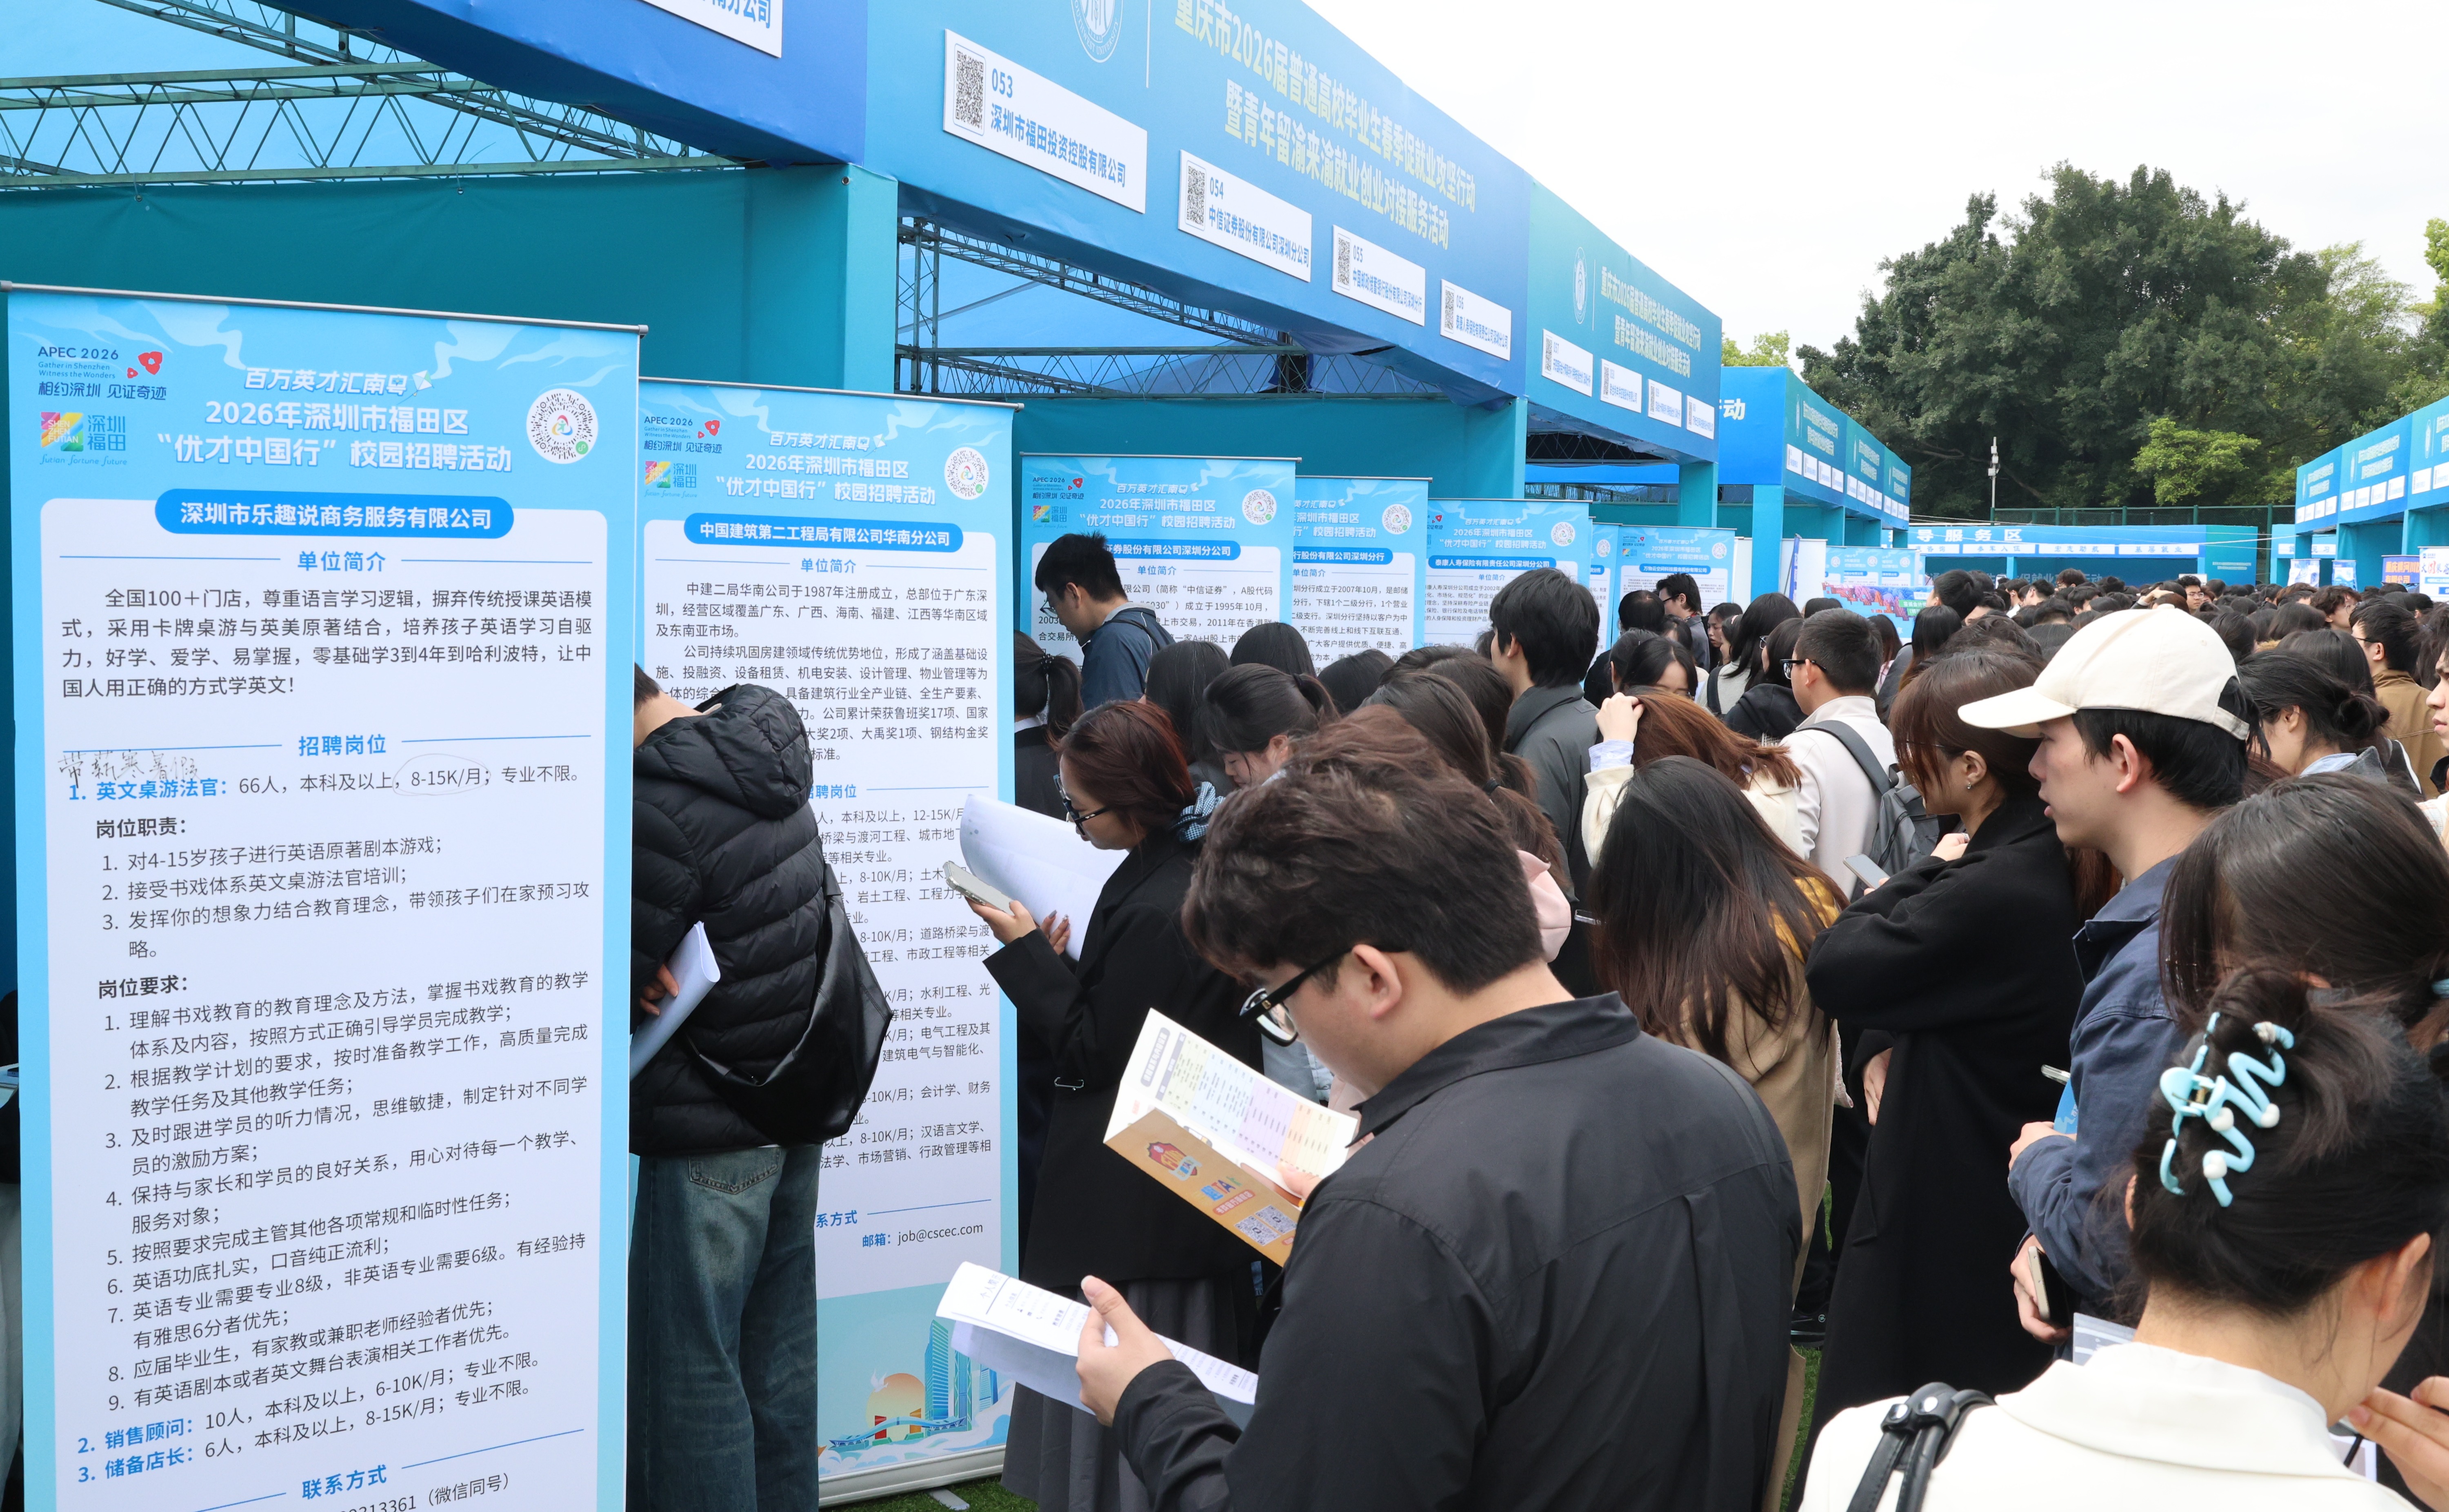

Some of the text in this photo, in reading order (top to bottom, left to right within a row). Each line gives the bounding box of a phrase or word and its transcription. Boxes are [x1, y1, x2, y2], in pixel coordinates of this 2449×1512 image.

[1096, 18, 1118, 55] UNIVERSITY
[991, 67, 1014, 99] 053
[1175, 0, 1475, 213] 重庆市2026届普通高校毕业生春季促就业攻坚行动
[991, 102, 1127, 188] 深圳市福田投资控股有限公司
[1225, 78, 1449, 250] 暨青年留渝来渝就业创业对接服务活动
[1209, 176, 1224, 201] 054
[1209, 205, 1309, 268] 中信证券股份有限公司深圳分公司
[1353, 244, 1363, 263] 055
[1353, 267, 1422, 313] 中国邮政储蓄银行股份有限公司深圳分行
[1456, 294, 1464, 310] 056
[38, 346, 119, 360] APEC 2026
[38, 382, 167, 401] 相约深圳 见证奇迹
[244, 366, 407, 396] 百万英才汇南粤
[48, 420, 70, 428] SHEN
[88, 415, 126, 433] 深圳
[205, 400, 469, 435] 2026年深圳市福田区
[644, 416, 693, 426] APEC 2026
[48, 427, 70, 435] ZHEN
[87, 433, 126, 451] 福田
[644, 440, 722, 454] 相约深圳 见证奇迹
[673, 463, 696, 475] 深圳
[745, 454, 909, 480] 2026年深圳市福田区
[673, 476, 696, 488] 福田
[180, 501, 491, 530] 深圳市乐趣说商务服务有限公司
[1099, 498, 1216, 512] 2026年深圳市福田区
[1293, 512, 1360, 524] 深圳市福田区
[700, 522, 950, 547] 中国建筑第二工程局有限公司华南分公司
[1453, 528, 1533, 538] 2026年深圳市福田区
[1888, 528, 2022, 542] 导服务区
[297, 550, 386, 573] 单位简介
[800, 558, 857, 573] 单位简介
[1293, 550, 1385, 562] 行股份有限公司深圳分行
[1435, 559, 1550, 568] 泰康人寿保险有限责任公司深圳分公司
[1137, 565, 1177, 576] 单位简介
[1293, 568, 1326, 577] 单位简介
[687, 582, 987, 602] 中建二局华南公司于1987年注册成立，总部位于广东深
[656, 603, 988, 622] 圳，经营区域覆盖广东、广西、海南、福建、江西等华南区域
[62, 618, 592, 638] 式，采用卡牌桌游与英美原著结合，培养孩子英语学习自驱
[656, 624, 740, 638] 及东南亚市场。
[1300, 626, 1404, 635] 不断完善线上和线下互联互通、
[62, 644, 591, 668] 力，好学、爱学、易掌握，零基础学3到4年到哈利波特，让中
[684, 645, 988, 661] 公司持续巩固房建领域传统优势地位，形成了涵盖基础设
[656, 666, 988, 680] 施、投融资、设备租赁、机电安装、设计管理、物业管理等为
[63, 676, 294, 698] 国人用正确的方式学英文！
[298, 733, 386, 757] 招聘岗位
[69, 784, 87, 800] 1.
[96, 816, 186, 839] 岗位职责：
[102, 836, 442, 872] 1. 对4-15岁孩子进行英语原著剧本游戏；
[102, 866, 406, 901] 2. 接受书戏体系英文桌游法官培训；
[102, 881, 589, 931] 3. 发挥你的想象力结合教育理念，带领孩子们在家预习攻
[129, 940, 157, 959] 略。
[98, 974, 187, 999] 岗位要求：
[104, 971, 589, 1031] 1. 理解书戏教育的教育理念及方法，掌握书戏教育的教学
[130, 1004, 511, 1059] 体系及内容，按照方式正确引导学员完成教学；
[104, 1023, 588, 1090] 2. 根据教学计划的要求，按时准备教学工作，高质量完成
[882, 1042, 985, 1063] 建筑电气与智能化、
[130, 1077, 353, 1118] 教学任务及其他教学任务；
[105, 1075, 587, 1149] 3. 及时跟进学员的听力情况，思维敏捷，制定针对不同学
[106, 1130, 577, 1207] 4. 保持与家长和学员的良好关系，用心对待每一个教学、
[132, 1144, 258, 1177] 员的激励方案；
[107, 1191, 511, 1266] 5. 按照要求完成主管其他各项常规和临时性任务；
[131, 1206, 220, 1235] 服务对象；
[897, 1223, 983, 1246] job@cscec.com
[107, 1236, 389, 1295] 6. 英语功底扎实，口音纯正流利；
[107, 1231, 586, 1324] 7. 英语专业需要专业8级，非英语专业需要6级。有经验持
[109, 1300, 493, 1382] 8. 应届毕业生，有家教或兼职老师经验者优先；
[133, 1309, 289, 1350] 有雅思6分者优先；
[109, 1323, 510, 1412] 9. 有英语剧本或者英文舞台表演相关工作者优先。
[78, 1437, 95, 1454] 2.
[78, 1467, 96, 1483] 3.
[302, 1464, 387, 1501] 联系方式
